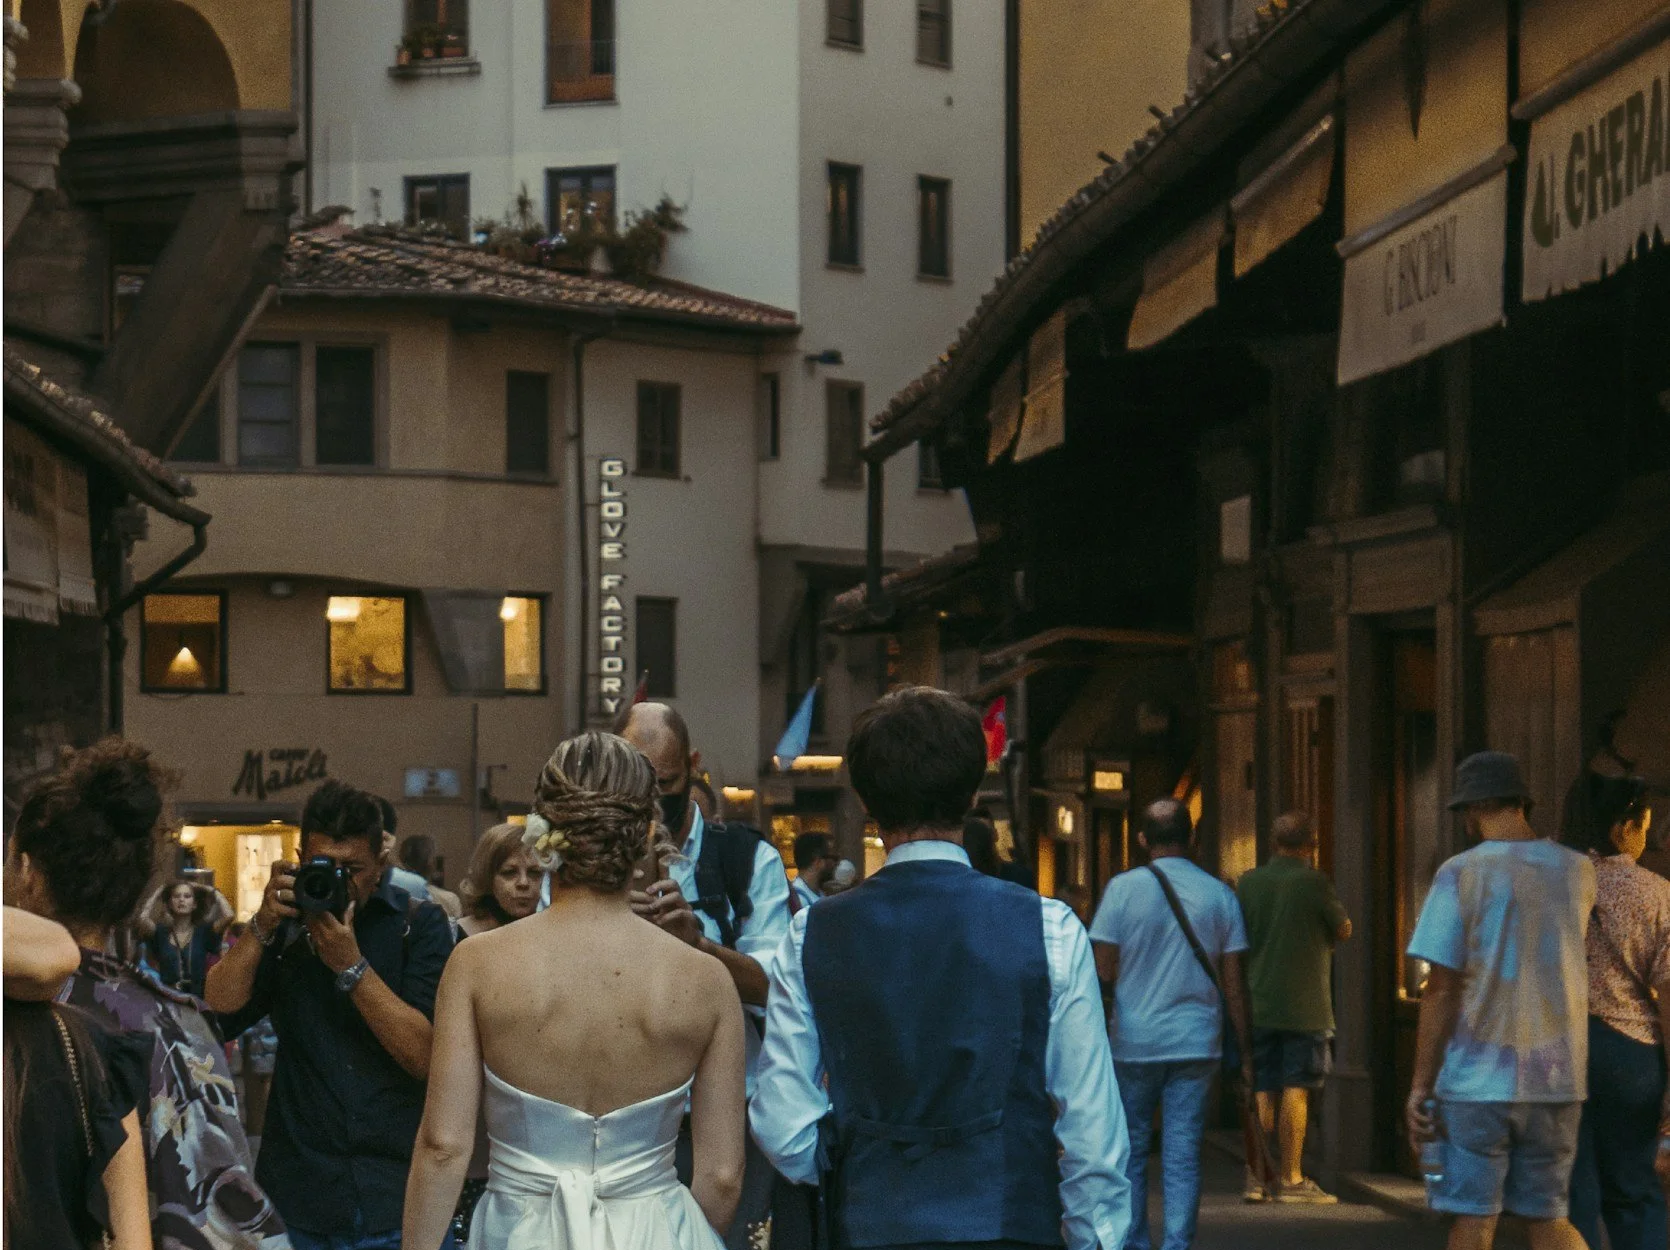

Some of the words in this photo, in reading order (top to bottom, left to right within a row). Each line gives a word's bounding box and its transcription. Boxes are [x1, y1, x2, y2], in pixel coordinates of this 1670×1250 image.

[1565, 70, 1670, 231] GHERA
[601, 460, 624, 559] GLOVE
[602, 574, 624, 713] FACTORY
